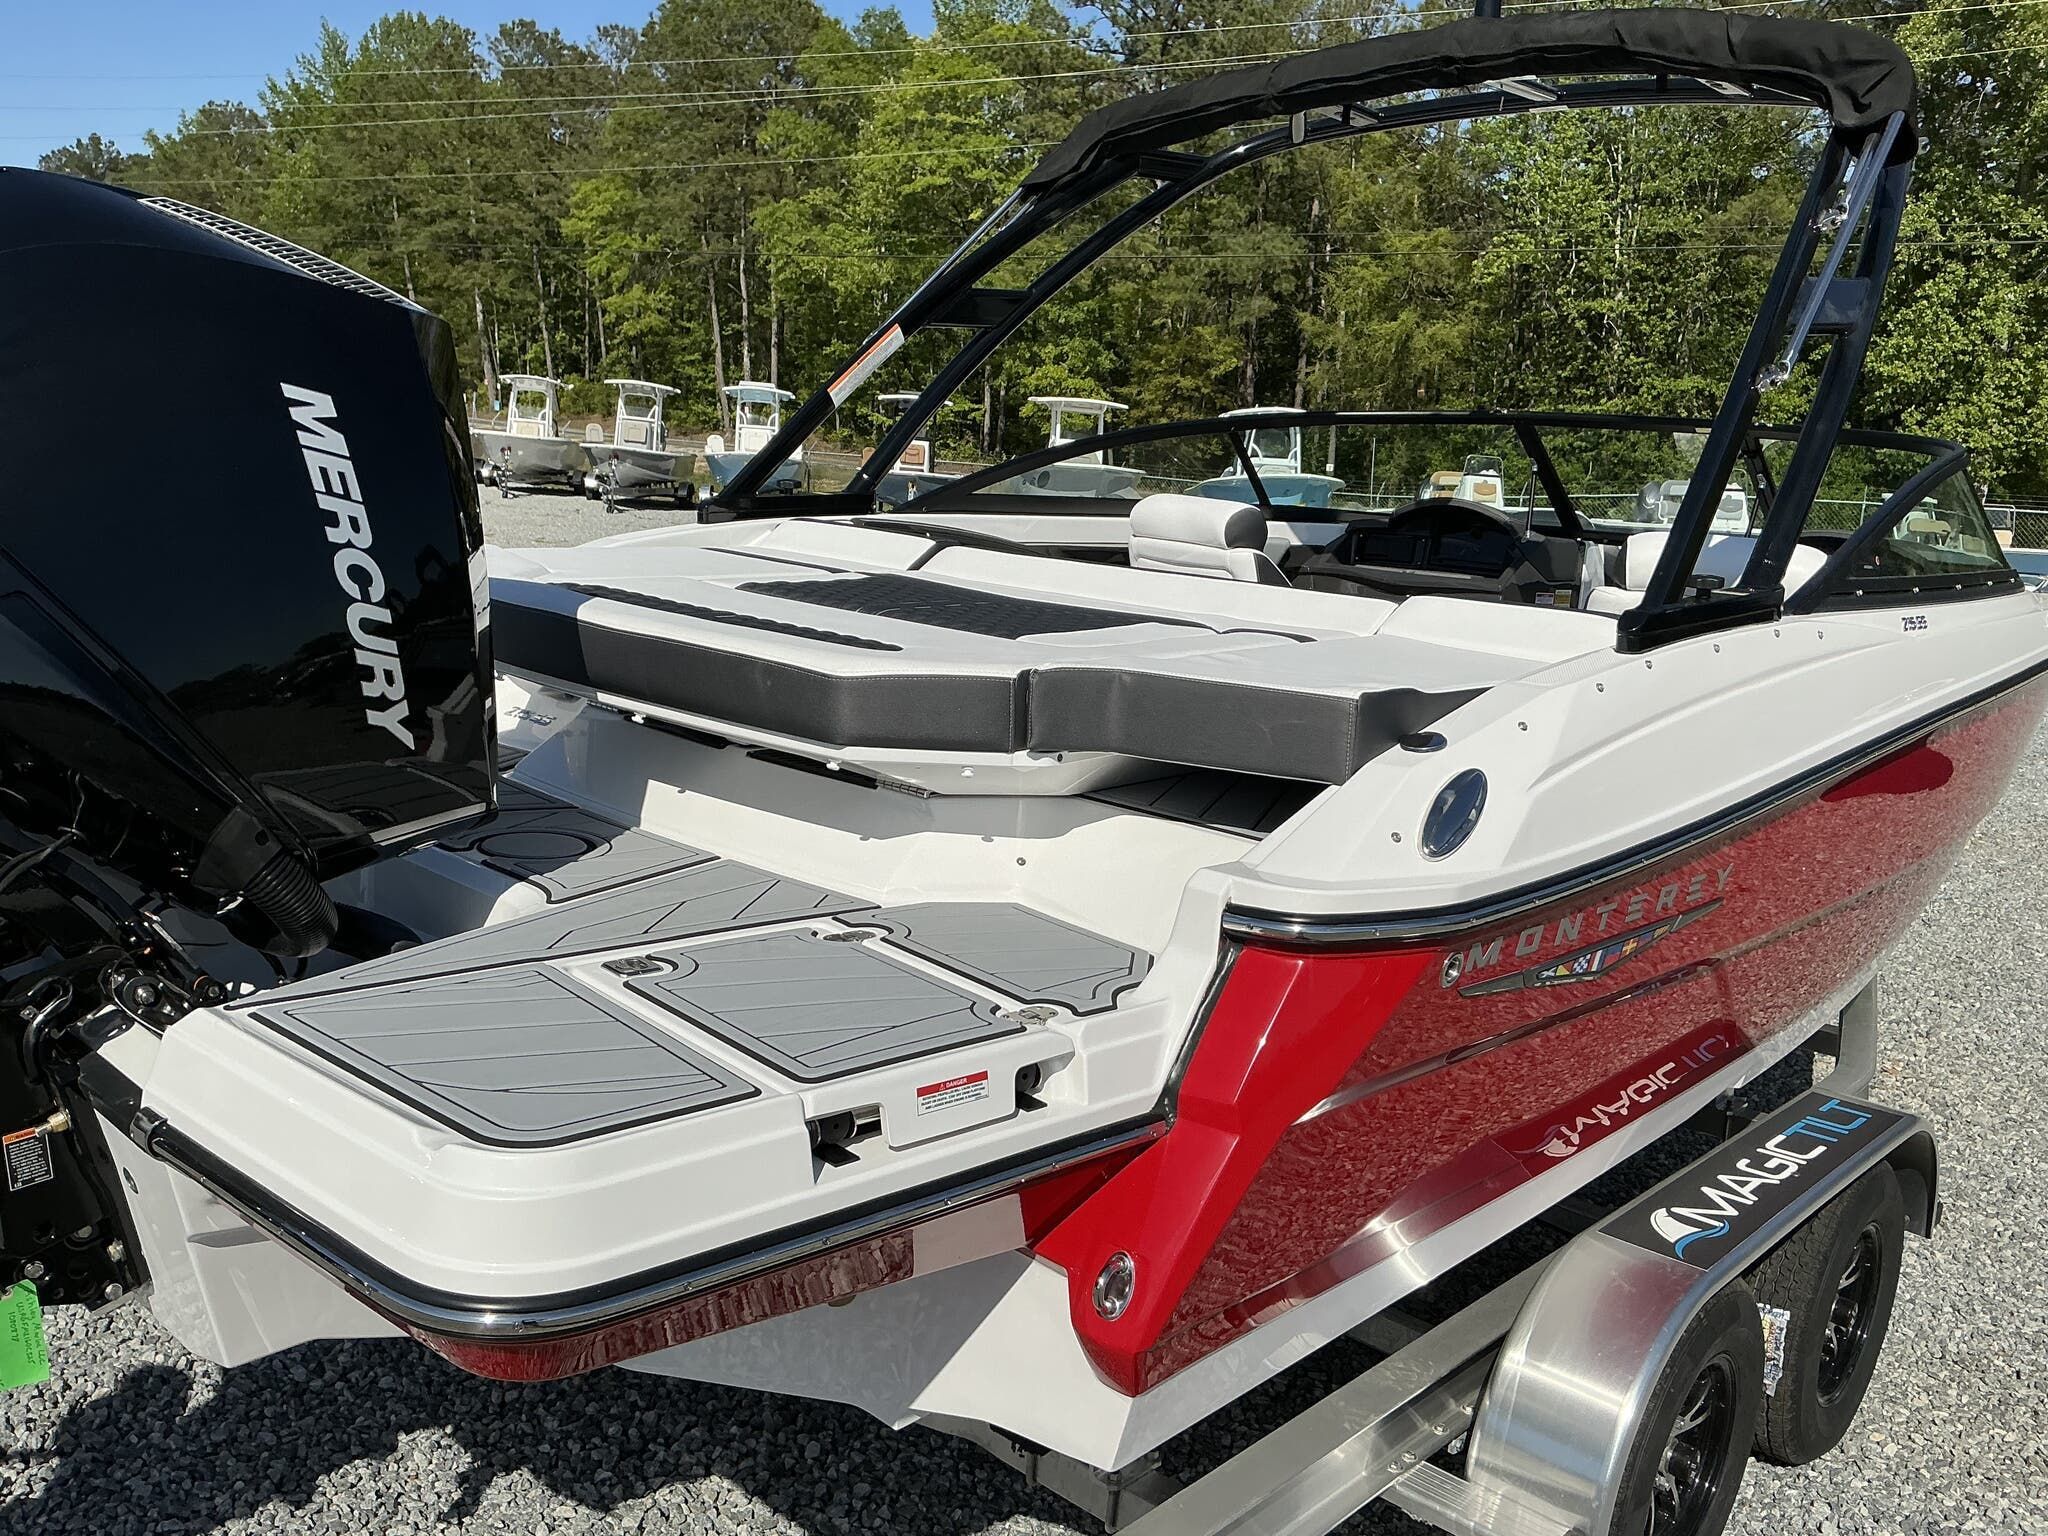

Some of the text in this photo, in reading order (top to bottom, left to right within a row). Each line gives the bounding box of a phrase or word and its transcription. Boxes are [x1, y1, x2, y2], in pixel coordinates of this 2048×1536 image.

[280, 382, 415, 751] MERCURY
[1464, 863, 1735, 972] MONTEREY
[946, 1077, 967, 1088] DANGER
